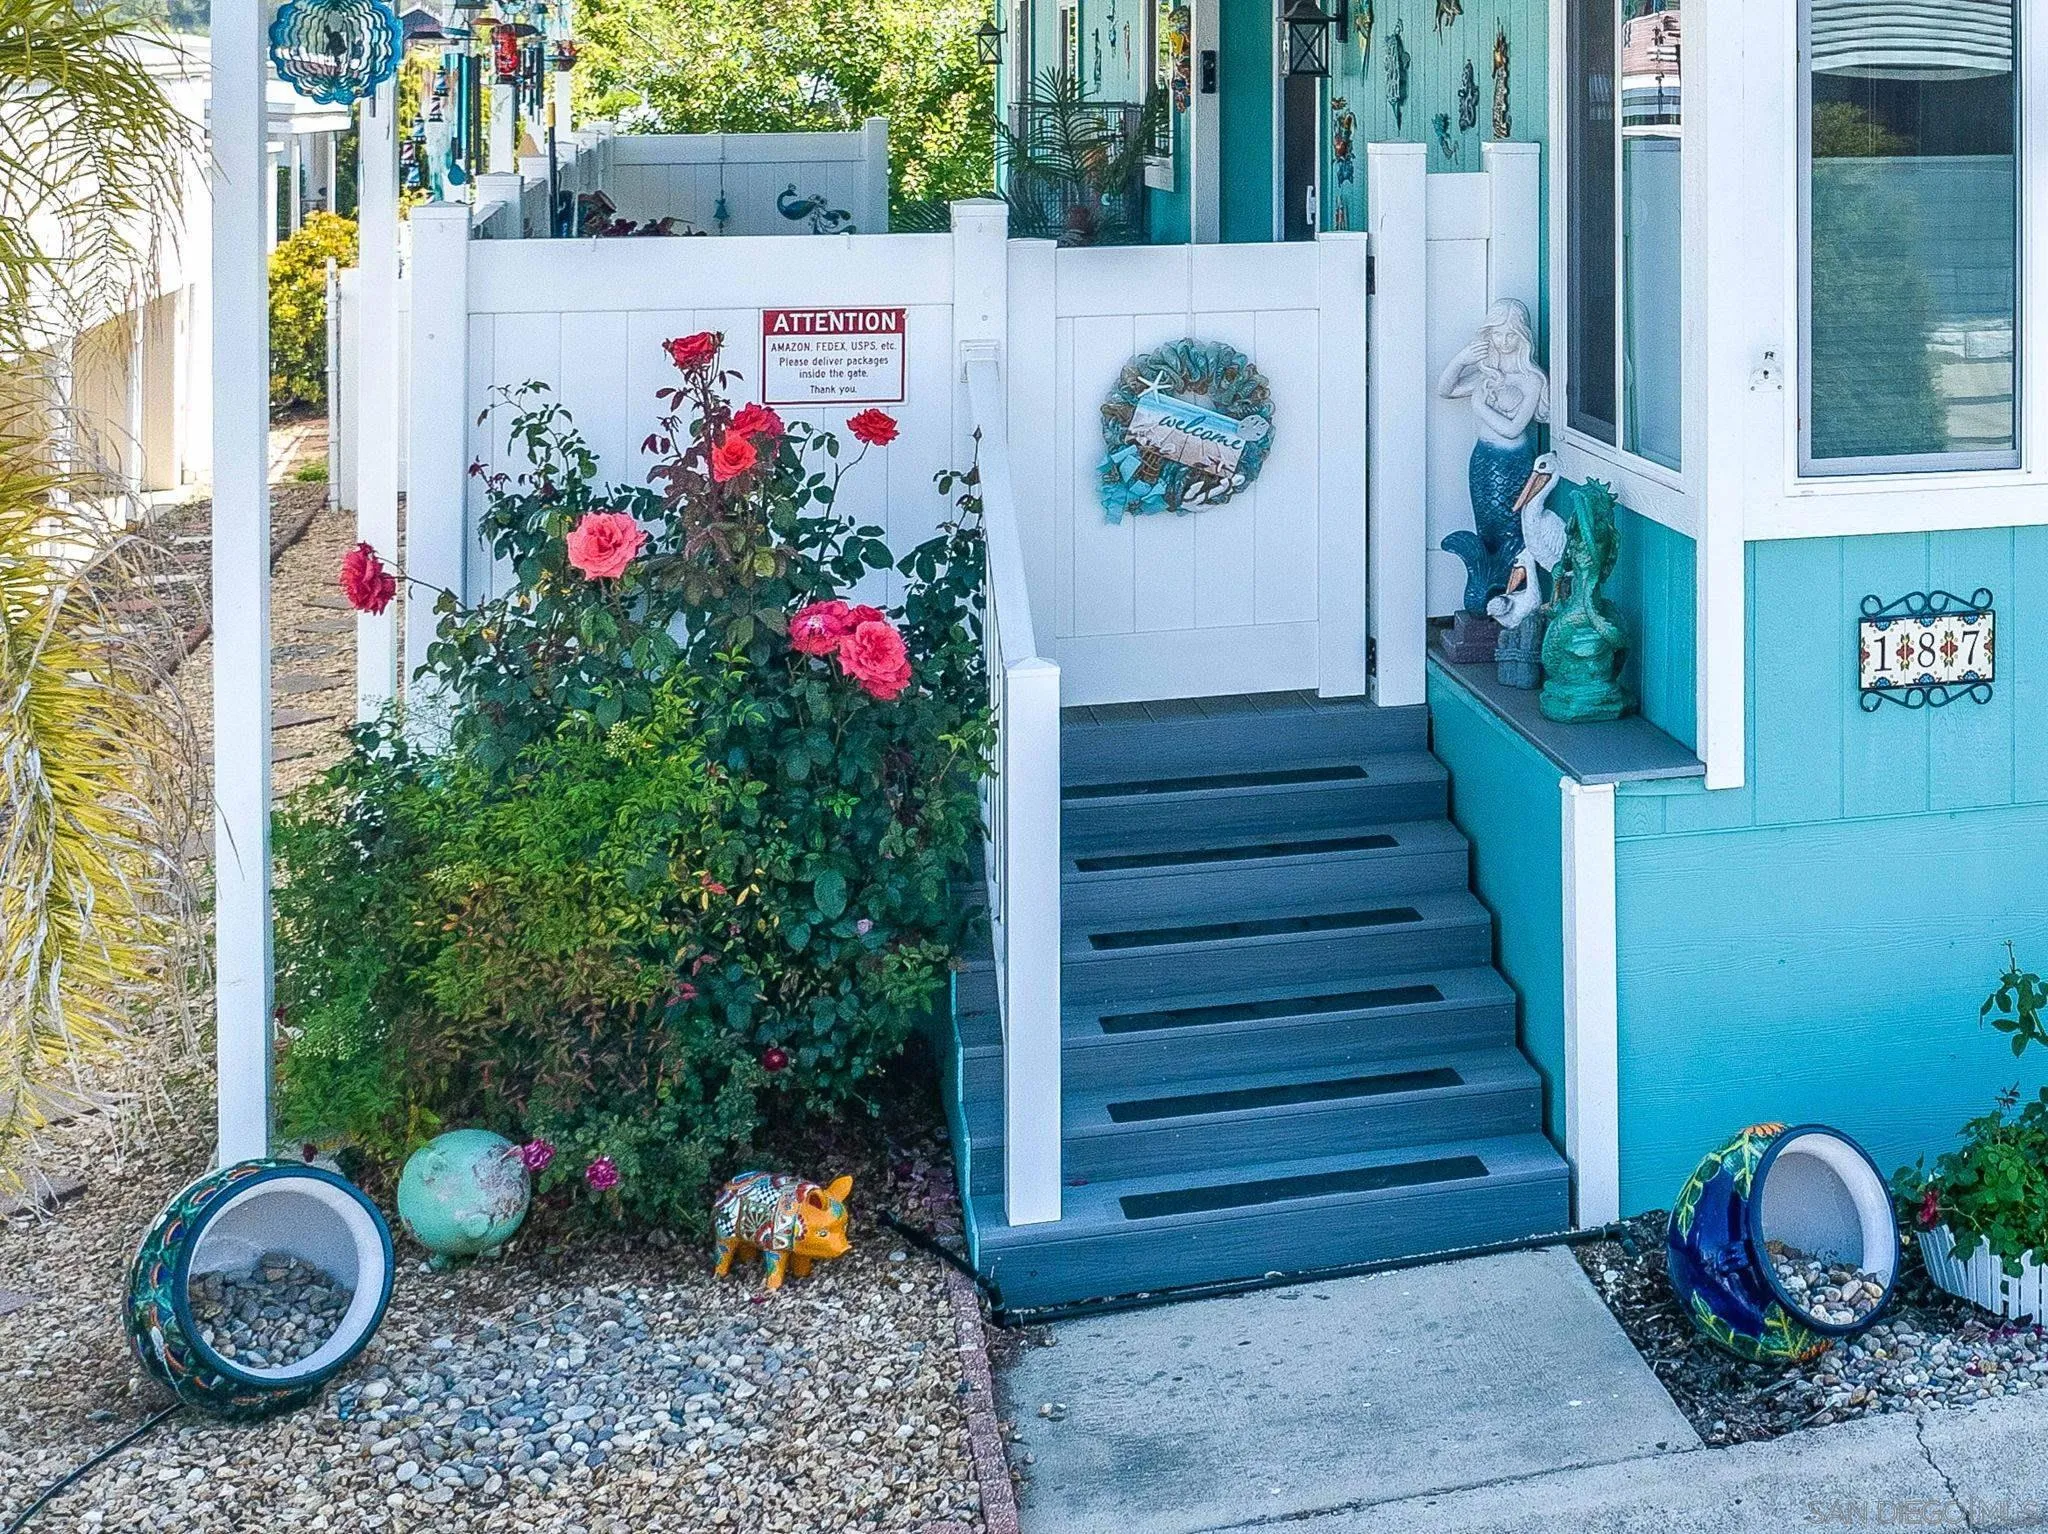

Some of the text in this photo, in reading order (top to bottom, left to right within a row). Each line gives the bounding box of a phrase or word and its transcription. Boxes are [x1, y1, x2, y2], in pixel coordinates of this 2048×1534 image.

[773, 311, 896, 332] ATTENTION
[881, 342, 897, 350] etc.
[779, 356, 889, 367] Please deliver packages
[799, 369, 869, 380] inside the gate.
[810, 385, 857, 395] Thank you.
[1159, 415, 1243, 450] welcome
[1874, 630, 1980, 672] 187
